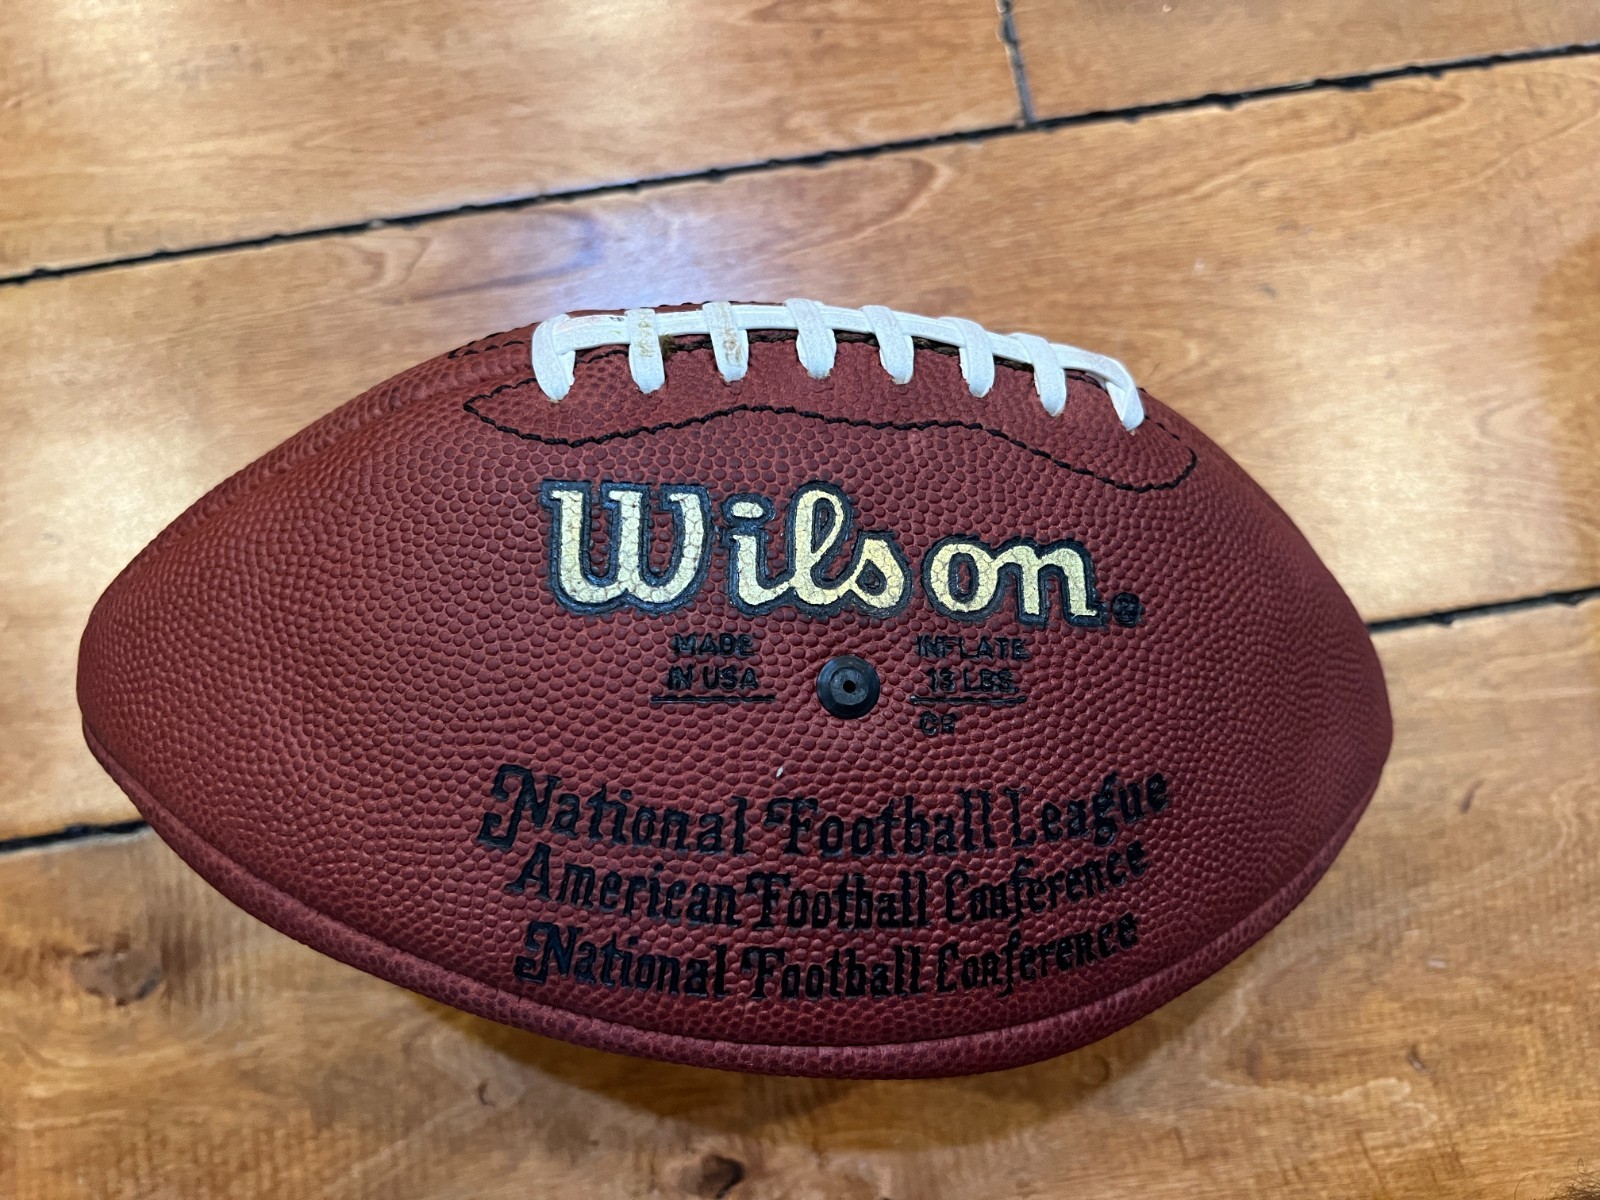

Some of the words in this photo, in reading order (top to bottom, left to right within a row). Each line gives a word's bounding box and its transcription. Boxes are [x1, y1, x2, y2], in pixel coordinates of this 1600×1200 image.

[541, 479, 1108, 627] Wilson
[673, 632, 755, 657] MADE
[916, 636, 1029, 661] INFLATE
[667, 666, 692, 691] IN
[702, 664, 759, 691] USA
[927, 668, 957, 693] 13
[476, 763, 750, 856] National
[764, 788, 997, 857] Football
[1003, 770, 1170, 849] League
[504, 841, 742, 928] American
[744, 870, 932, 932] Football
[944, 840, 1148, 928] Conference
[513, 920, 731, 998] National
[741, 943, 927, 1000] Football
[935, 912, 1139, 997] Conference
